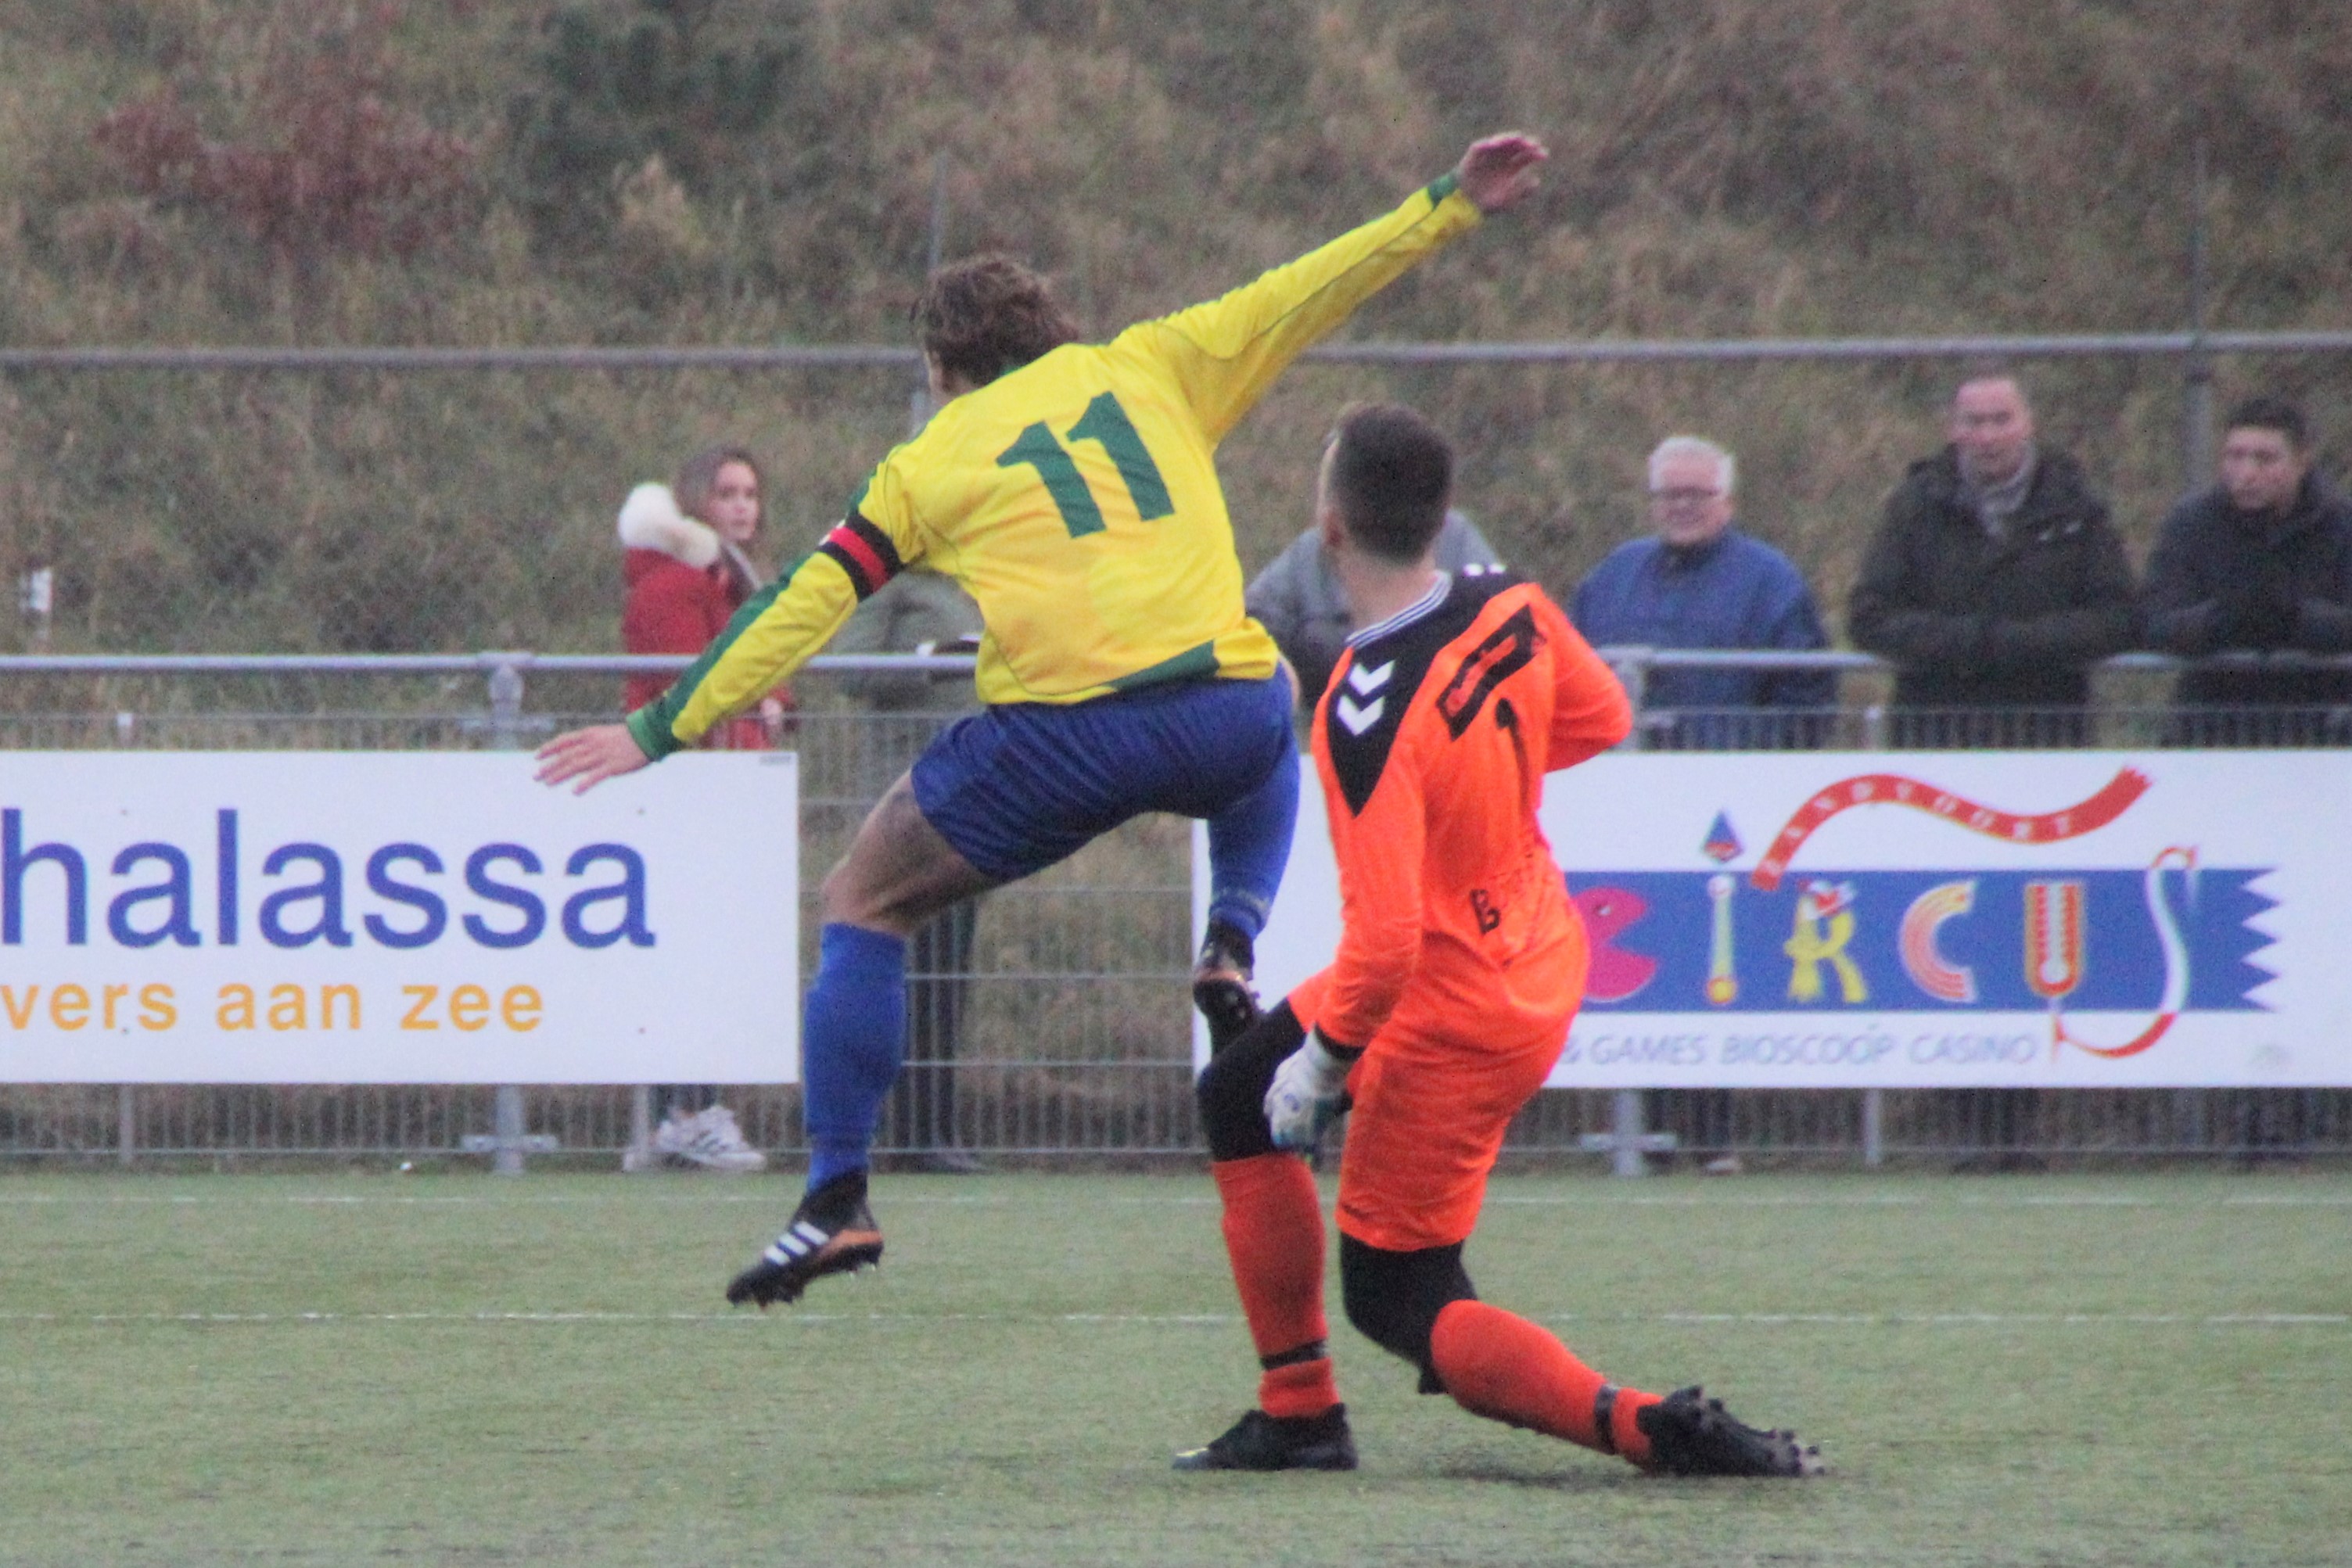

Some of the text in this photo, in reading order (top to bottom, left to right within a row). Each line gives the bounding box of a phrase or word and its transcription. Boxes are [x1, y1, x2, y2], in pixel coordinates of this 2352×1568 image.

[996, 391, 1175, 539] 11
[2, 809, 656, 949] halassa
[0, 983, 545, 1032] vers aan zee
[1590, 1035, 1706, 1065] GAMES
[1719, 1034, 1896, 1065] BIOSCOOP
[1910, 1033, 2038, 1064] CASINO
